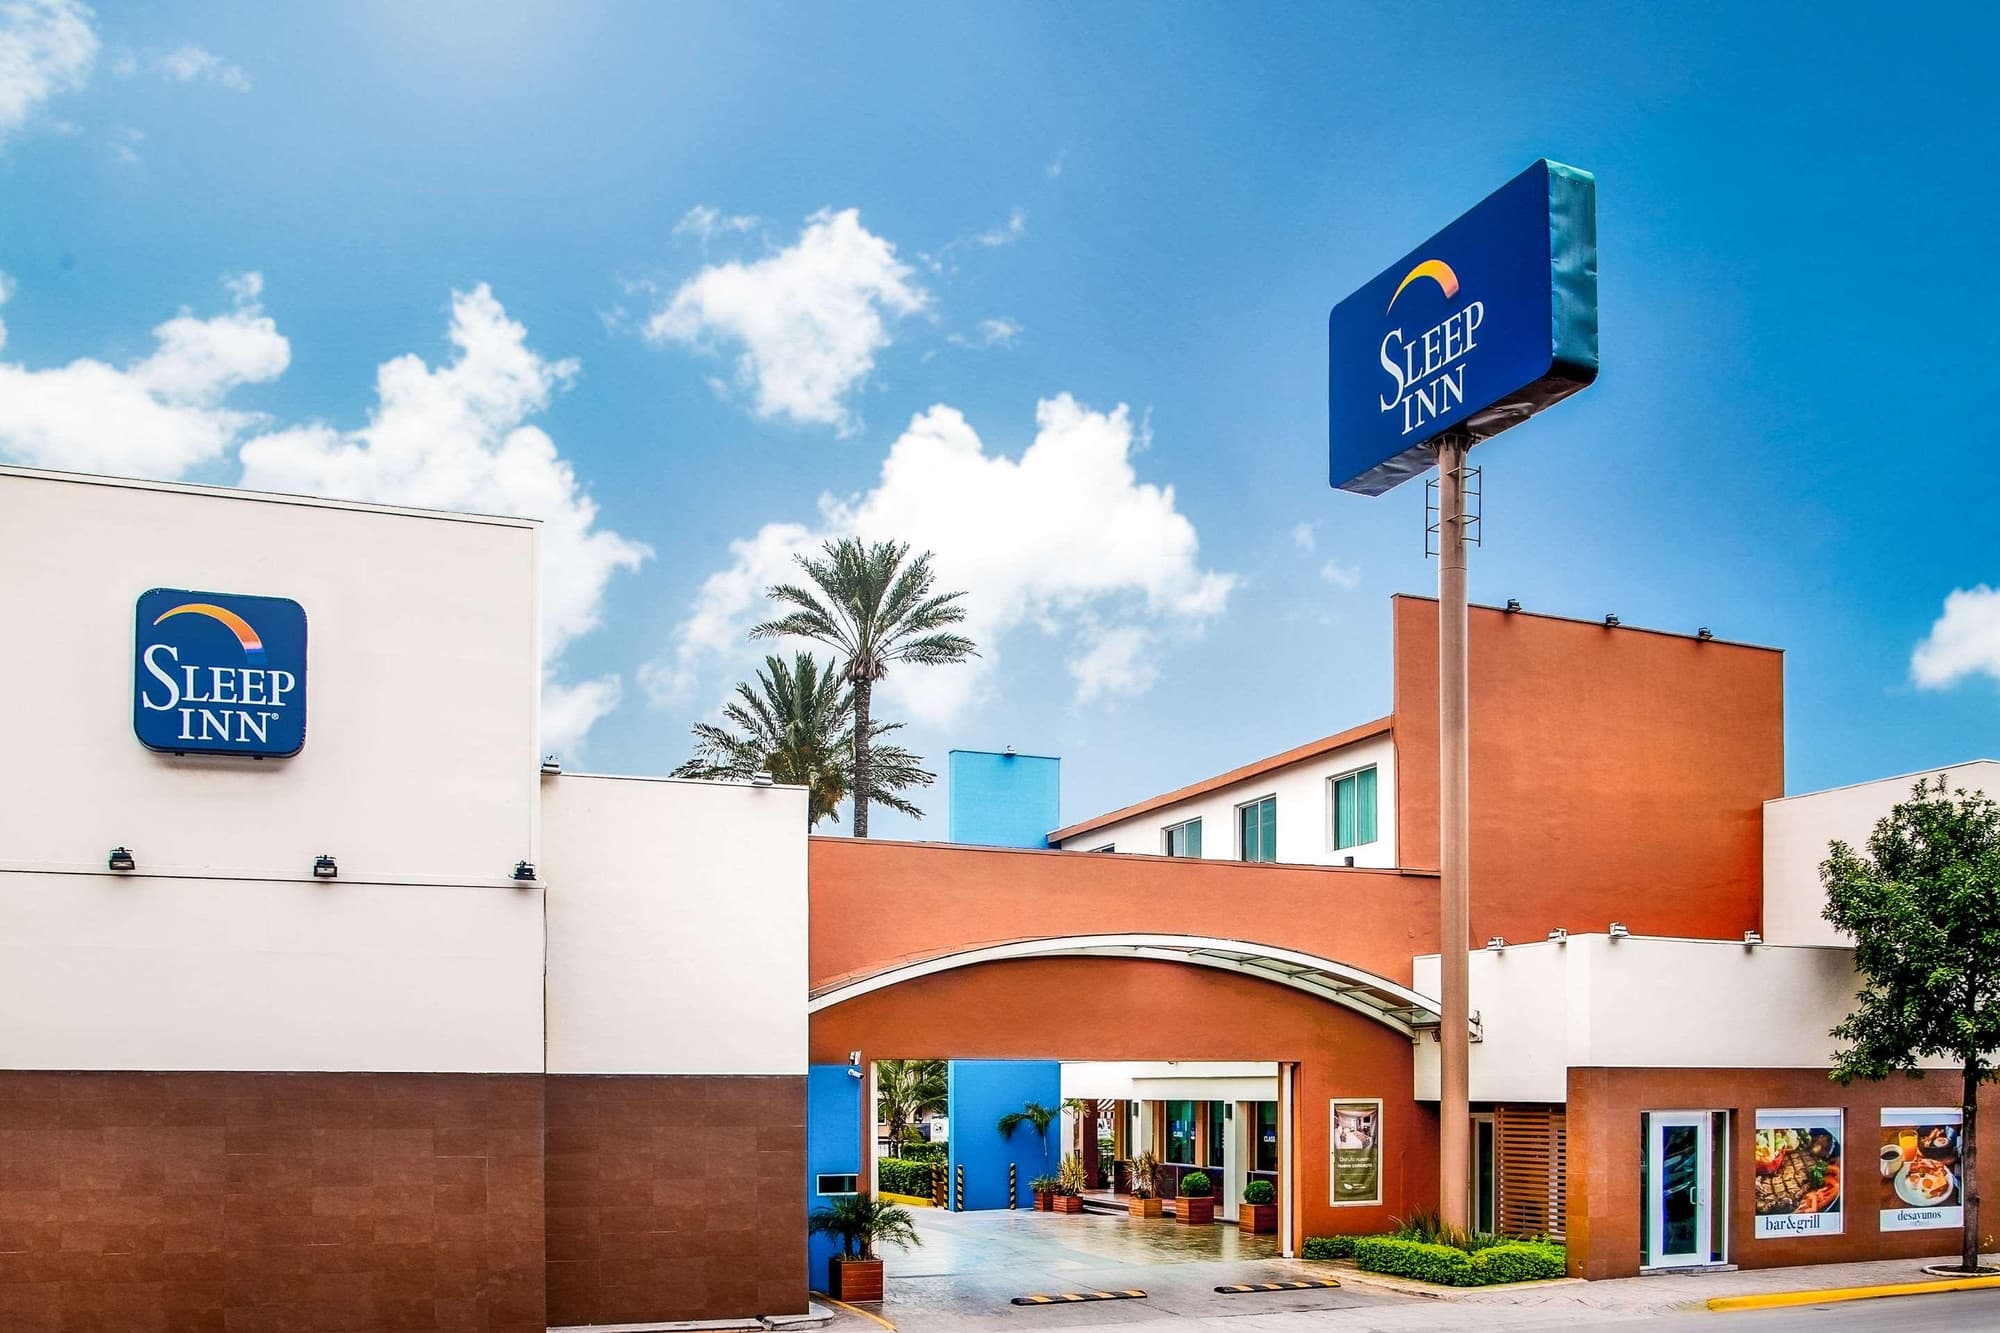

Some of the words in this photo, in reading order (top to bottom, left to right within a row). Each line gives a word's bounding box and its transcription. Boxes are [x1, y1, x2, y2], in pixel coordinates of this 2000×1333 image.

[1379, 300, 1485, 413] SLEEP
[1400, 363, 1467, 436] INN
[142, 643, 296, 711] SLEEP
[1765, 1214, 1821, 1233] bar&grill
[1897, 1209, 1942, 1223] desayunos
